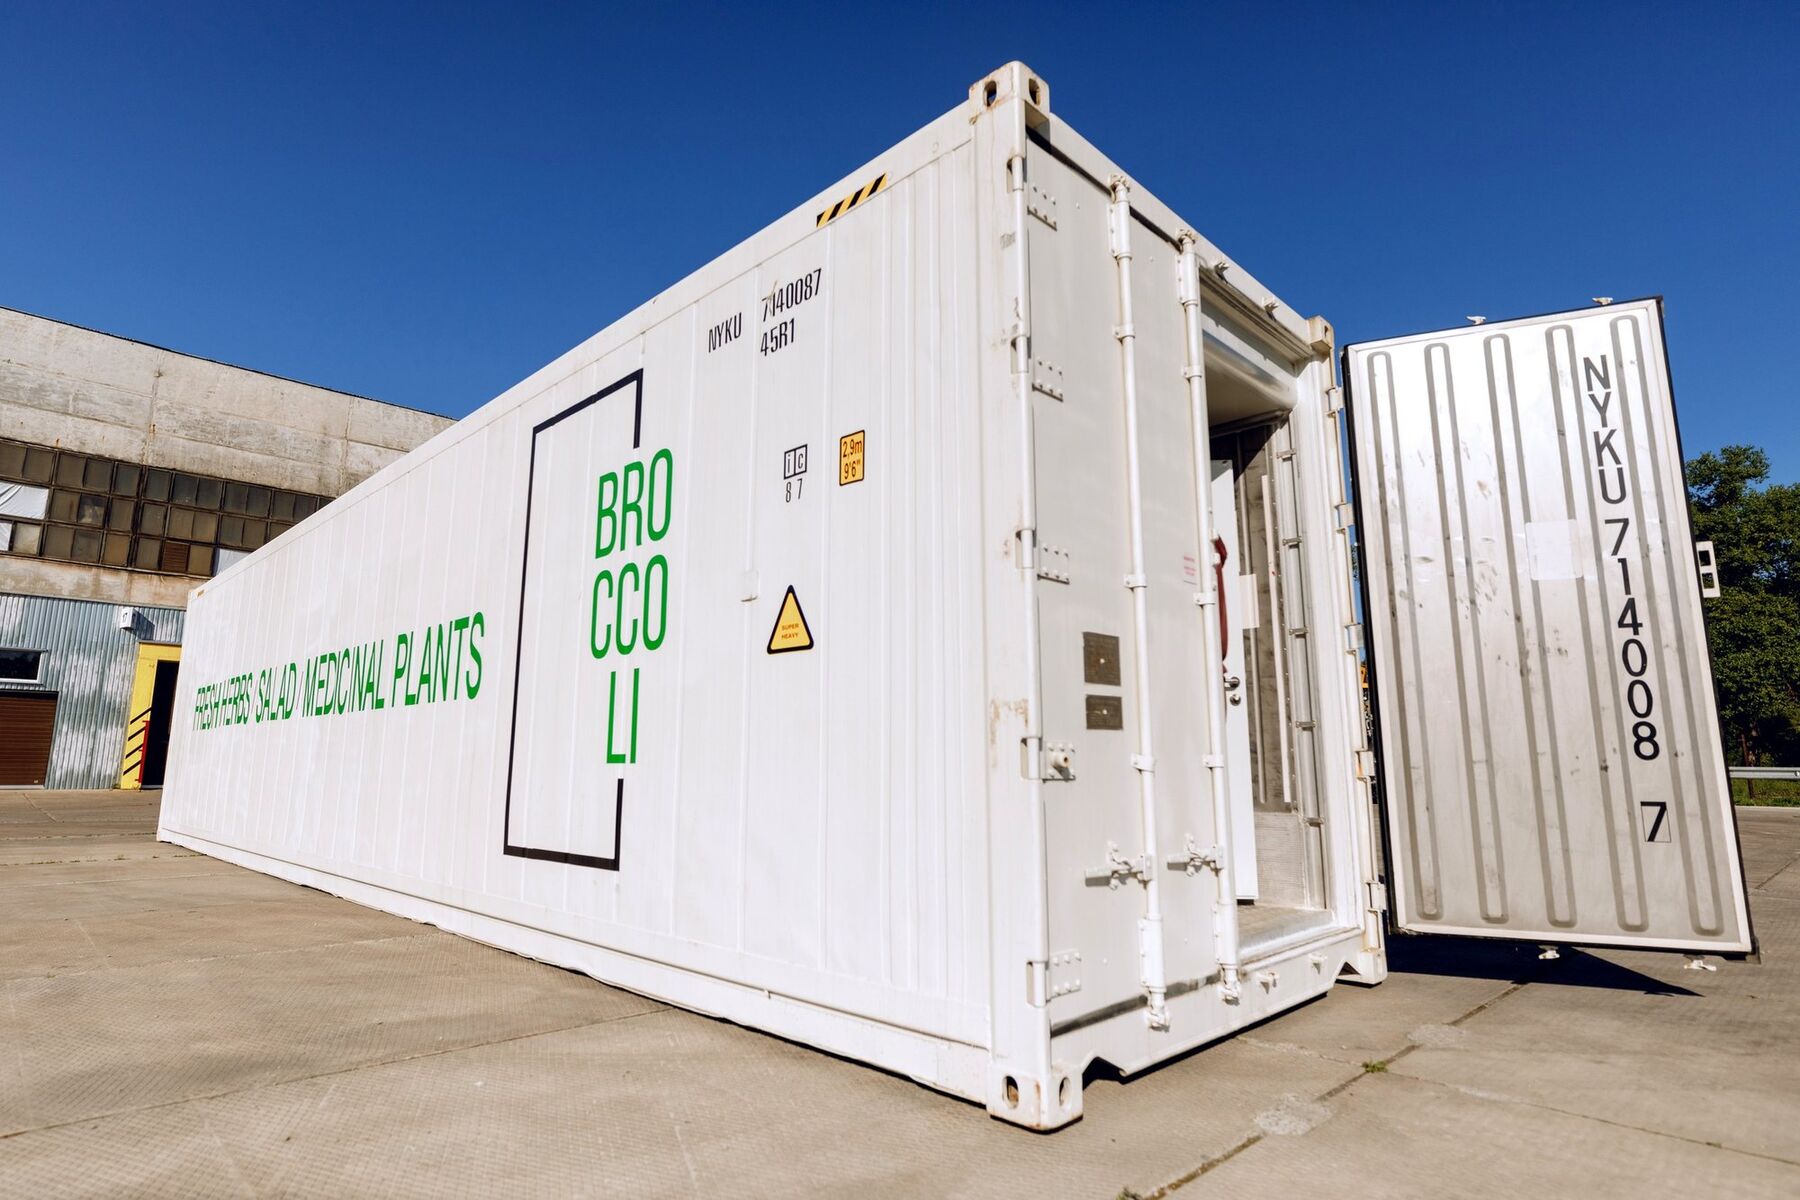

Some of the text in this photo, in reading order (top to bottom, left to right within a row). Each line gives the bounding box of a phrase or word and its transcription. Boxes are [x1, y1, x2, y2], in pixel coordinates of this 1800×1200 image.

[708, 267, 822, 353] NYKU 7140087
[760, 317, 795, 357] 45R1
[595, 448, 673, 559] BRO
[591, 554, 669, 660] CCO
[1583, 354, 1668, 843] NYKU 714008 7
[192, 683, 222, 731] FRESH
[219, 672, 253, 727] HERBS
[255, 662, 297, 723] SALAD
[302, 639, 385, 718] MEDICINAL
[391, 611, 485, 708] PLANTS
[606, 668, 640, 764] LI
